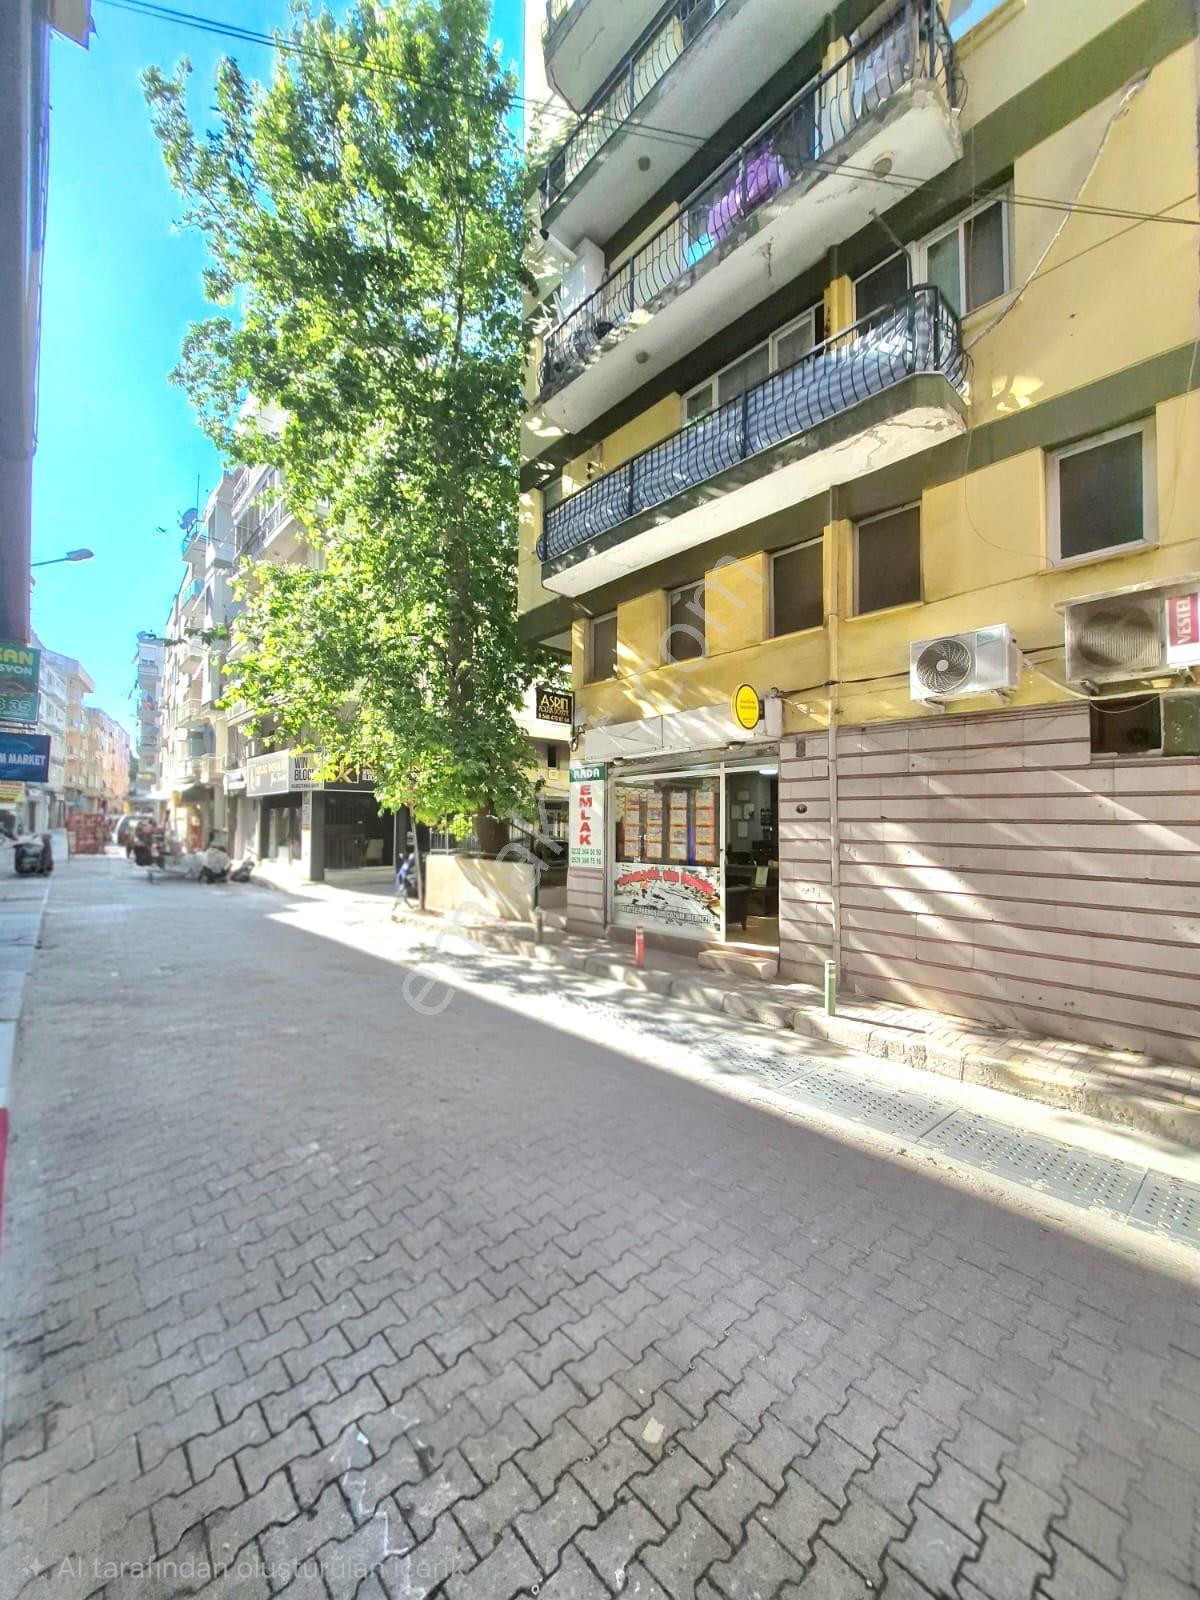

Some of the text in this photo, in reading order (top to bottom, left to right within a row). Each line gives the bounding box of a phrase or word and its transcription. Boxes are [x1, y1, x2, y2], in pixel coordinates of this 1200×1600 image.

[0, 648, 33, 665] AN
[9, 753, 46, 766] MARKET
[579, 785, 593, 846] EMLAK
